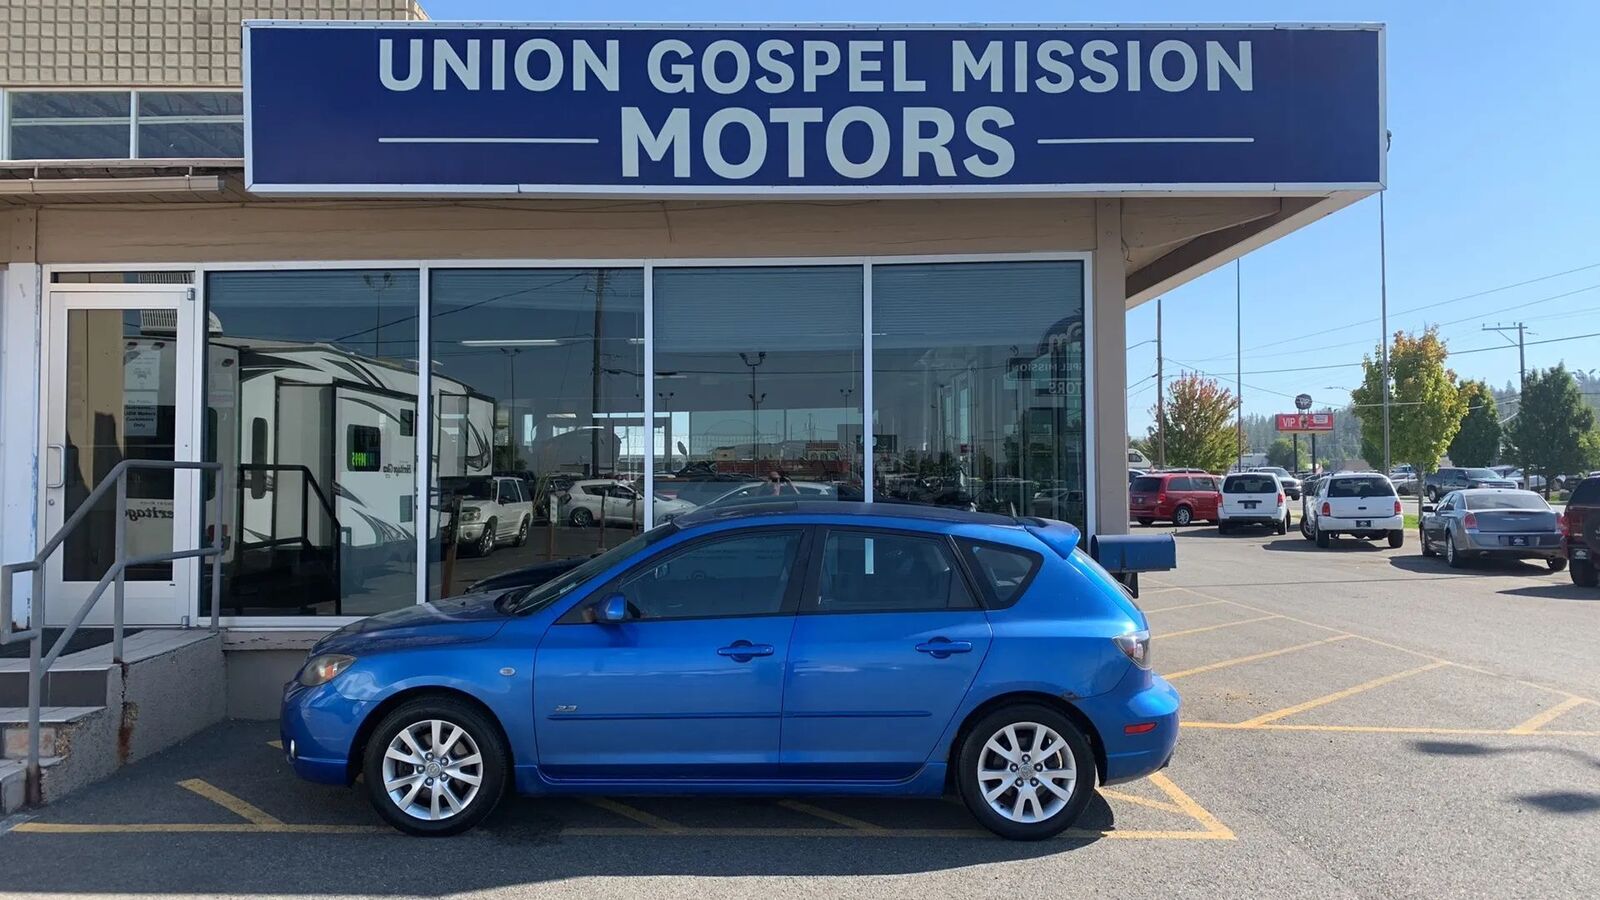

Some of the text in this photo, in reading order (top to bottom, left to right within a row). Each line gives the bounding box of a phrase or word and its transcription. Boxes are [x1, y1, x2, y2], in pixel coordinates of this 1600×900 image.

[379, 39, 1253, 94] UNION GOSPEL MISSION
[621, 105, 1015, 179] MOTORS
[1282, 417, 1296, 428] VIP
